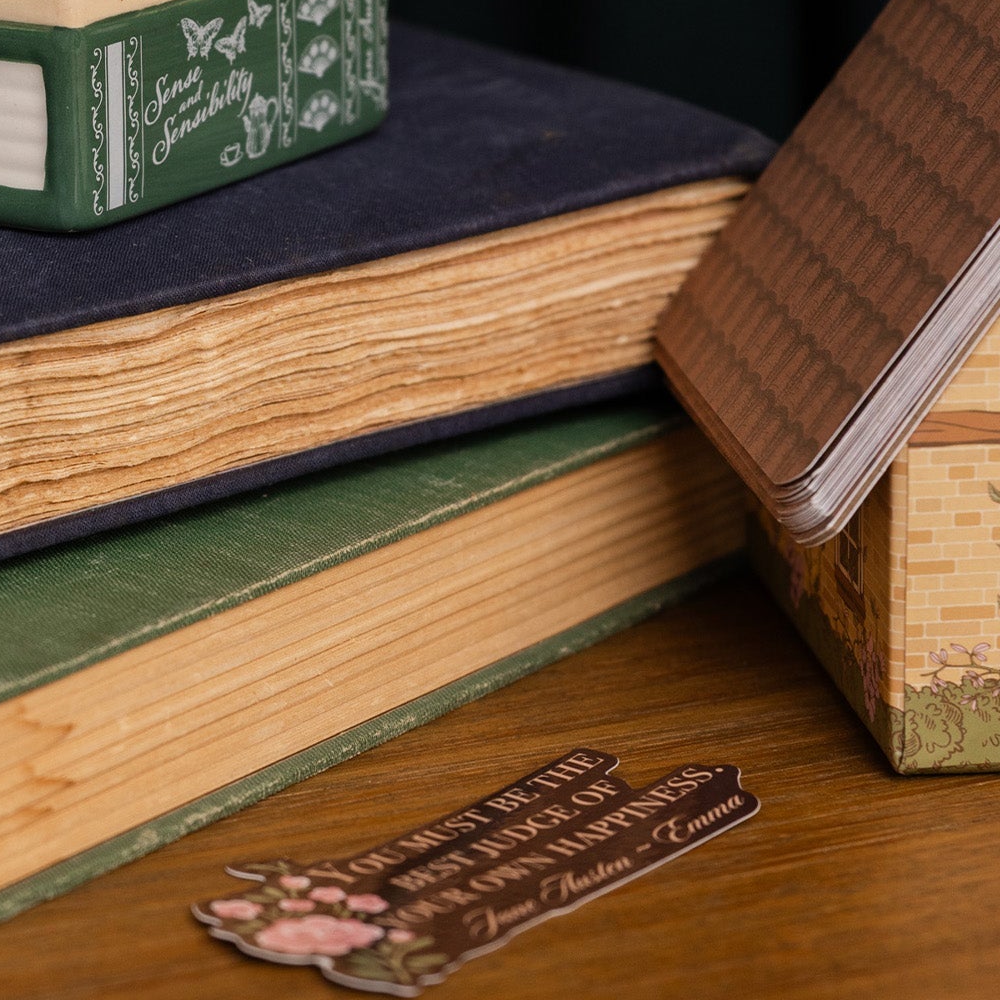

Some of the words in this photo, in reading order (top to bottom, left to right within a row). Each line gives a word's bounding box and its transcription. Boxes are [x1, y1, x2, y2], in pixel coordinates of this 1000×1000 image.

[144, 65, 203, 126] Sense
[152, 66, 254, 166] Sensibility
[178, 79, 204, 113] and
[307, 849, 407, 884] YOU
[398, 808, 492, 850] MUST
[485, 787, 541, 813] BE
[528, 752, 605, 789] THE
[390, 851, 477, 891] BEST
[471, 803, 581, 859] JUDGE
[571, 779, 620, 806] OF
[469, 851, 556, 892] OWN
[546, 767, 725, 856] HAPPINESS.
[539, 856, 635, 904] Austen
[651, 793, 746, 844] Emma
